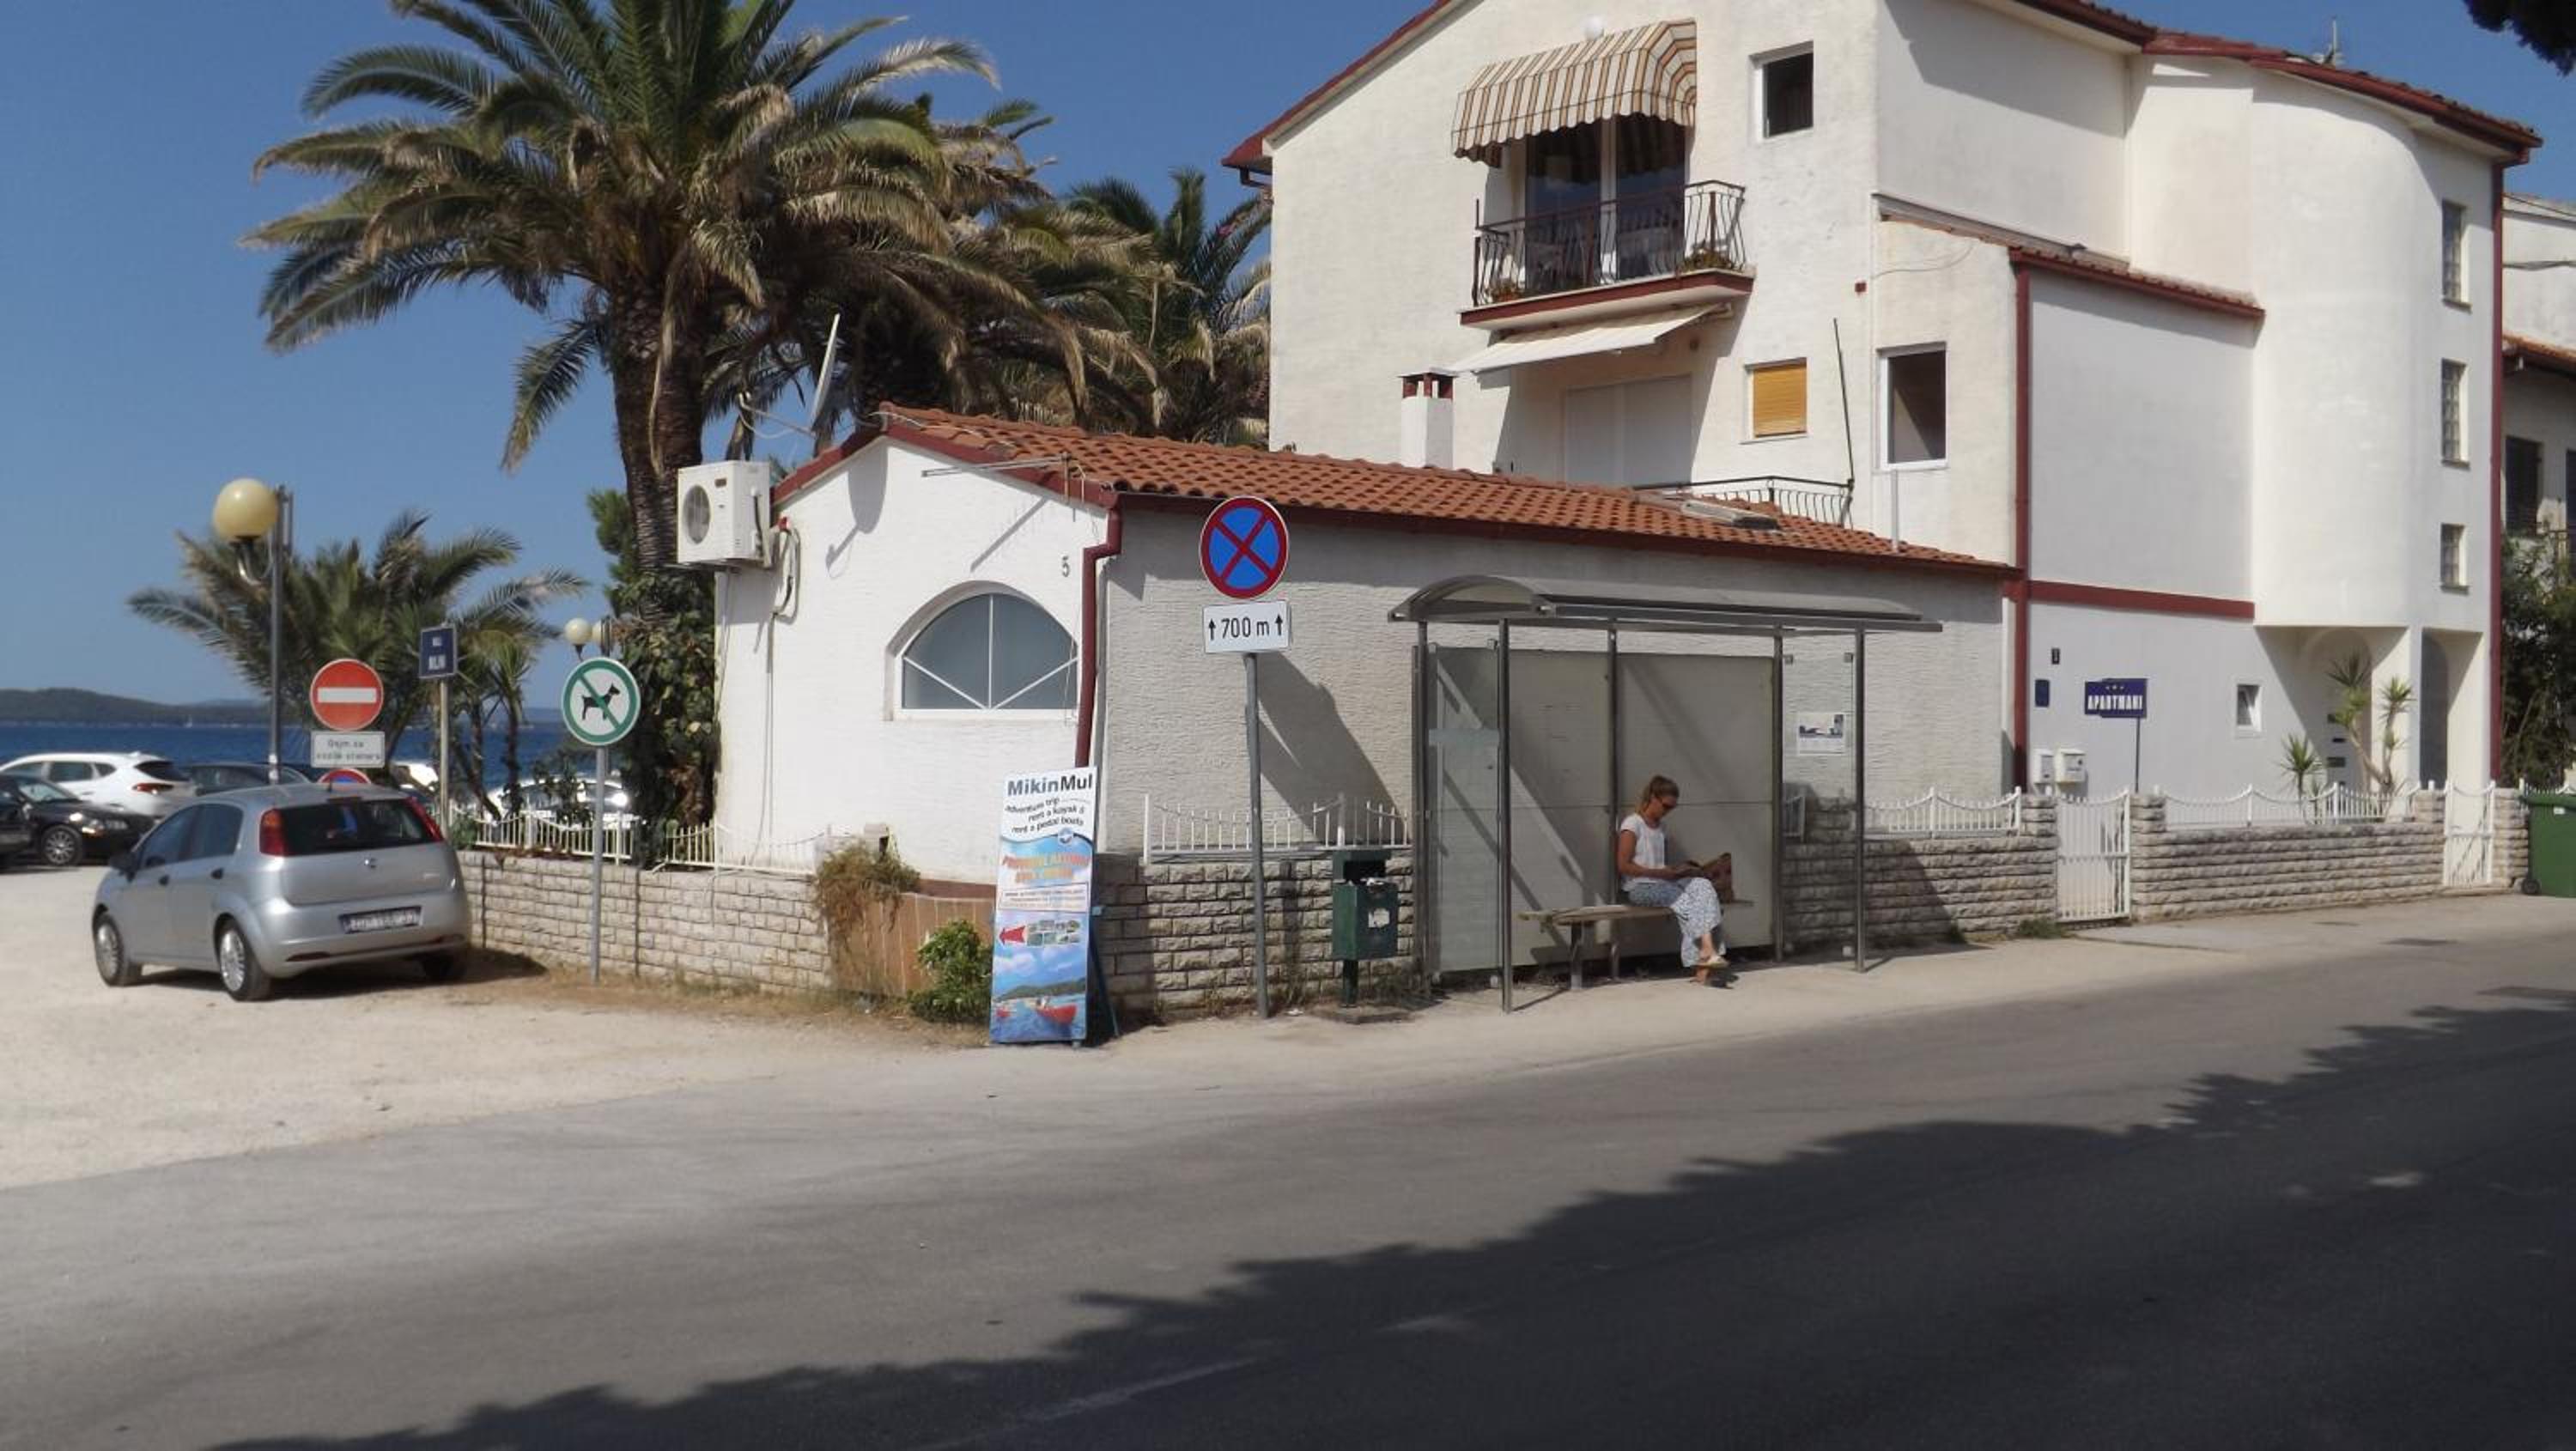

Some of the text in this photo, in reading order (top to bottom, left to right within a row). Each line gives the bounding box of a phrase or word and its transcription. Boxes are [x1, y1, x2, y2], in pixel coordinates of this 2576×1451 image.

[1221, 616, 1270, 638] 700 m
[1007, 774, 1093, 796] MikinMul
[1046, 797, 1060, 806] trip
[1029, 811, 1045, 823] rent
[1053, 805, 1078, 816] kayak
[1012, 825, 1029, 834] rent
[1036, 817, 1060, 832] pedal
